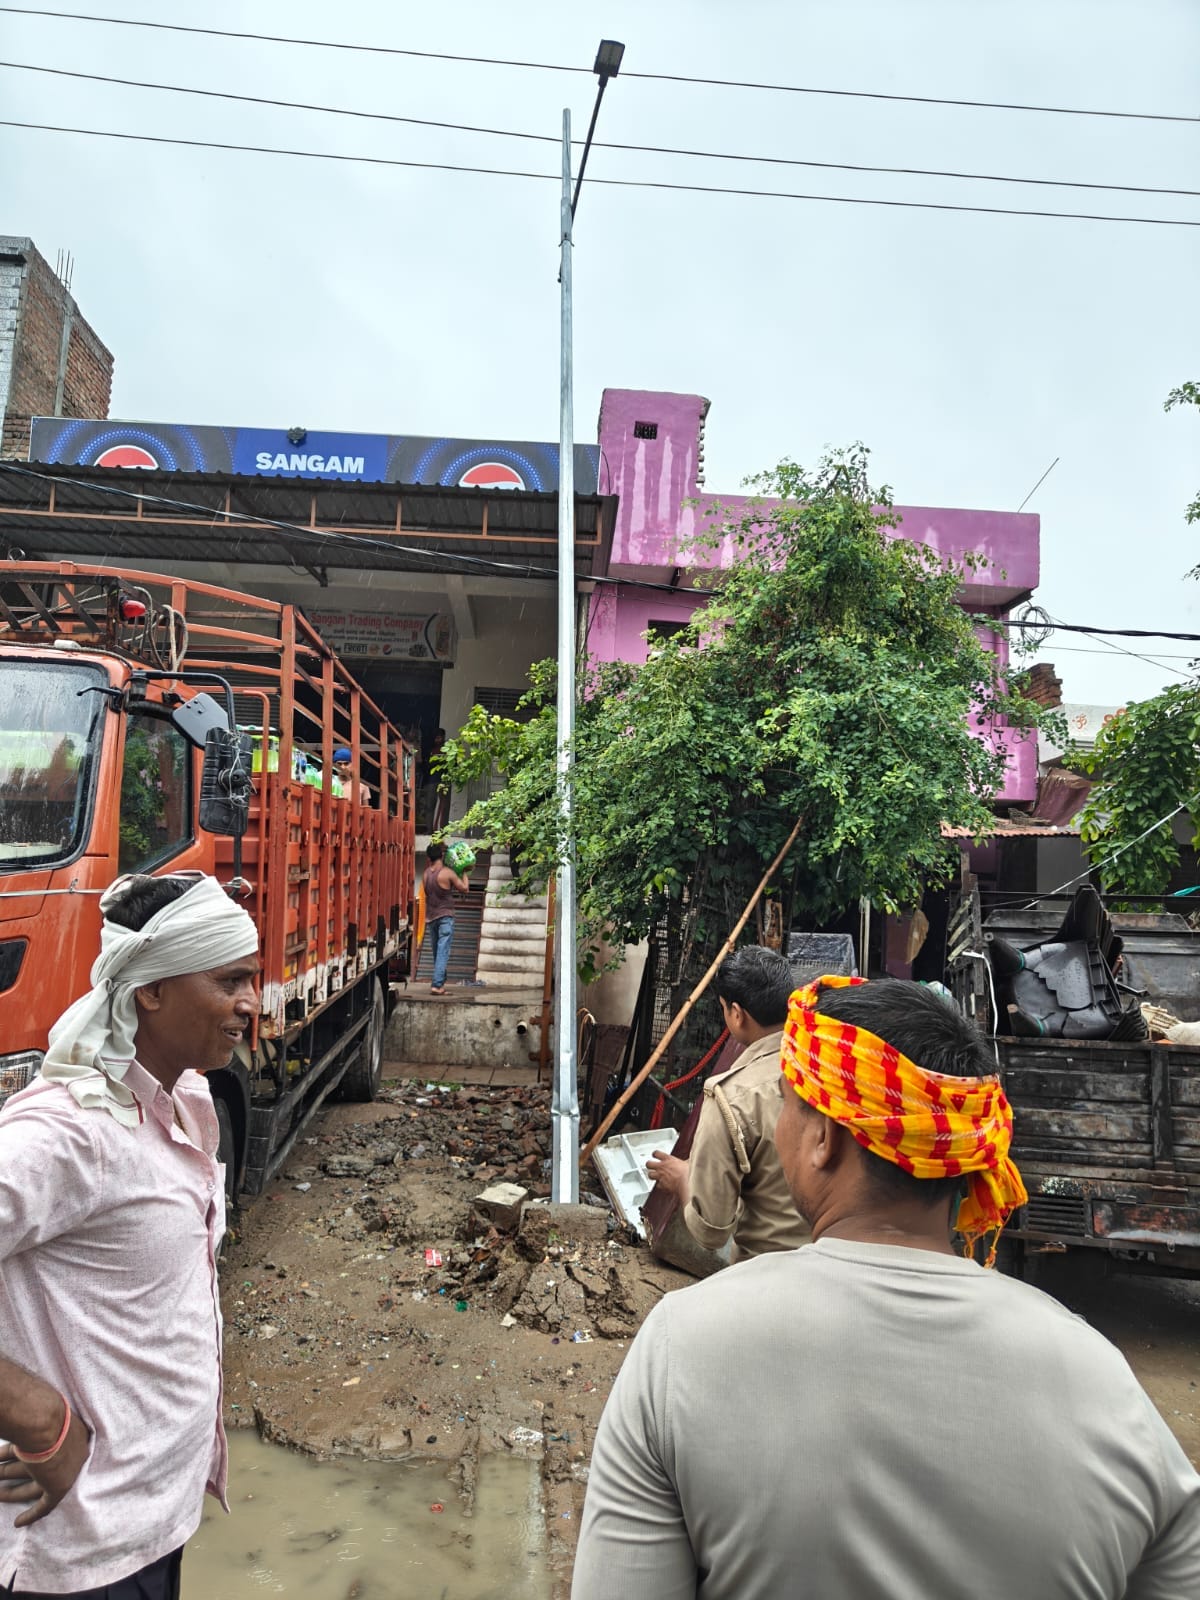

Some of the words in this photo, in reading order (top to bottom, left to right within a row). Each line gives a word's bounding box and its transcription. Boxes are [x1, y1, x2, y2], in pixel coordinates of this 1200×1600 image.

[256, 452, 365, 474] SANGAM
[311, 612, 346, 627] Sangam
[349, 614, 382, 629] Trading
[384, 616, 425, 632] Company
